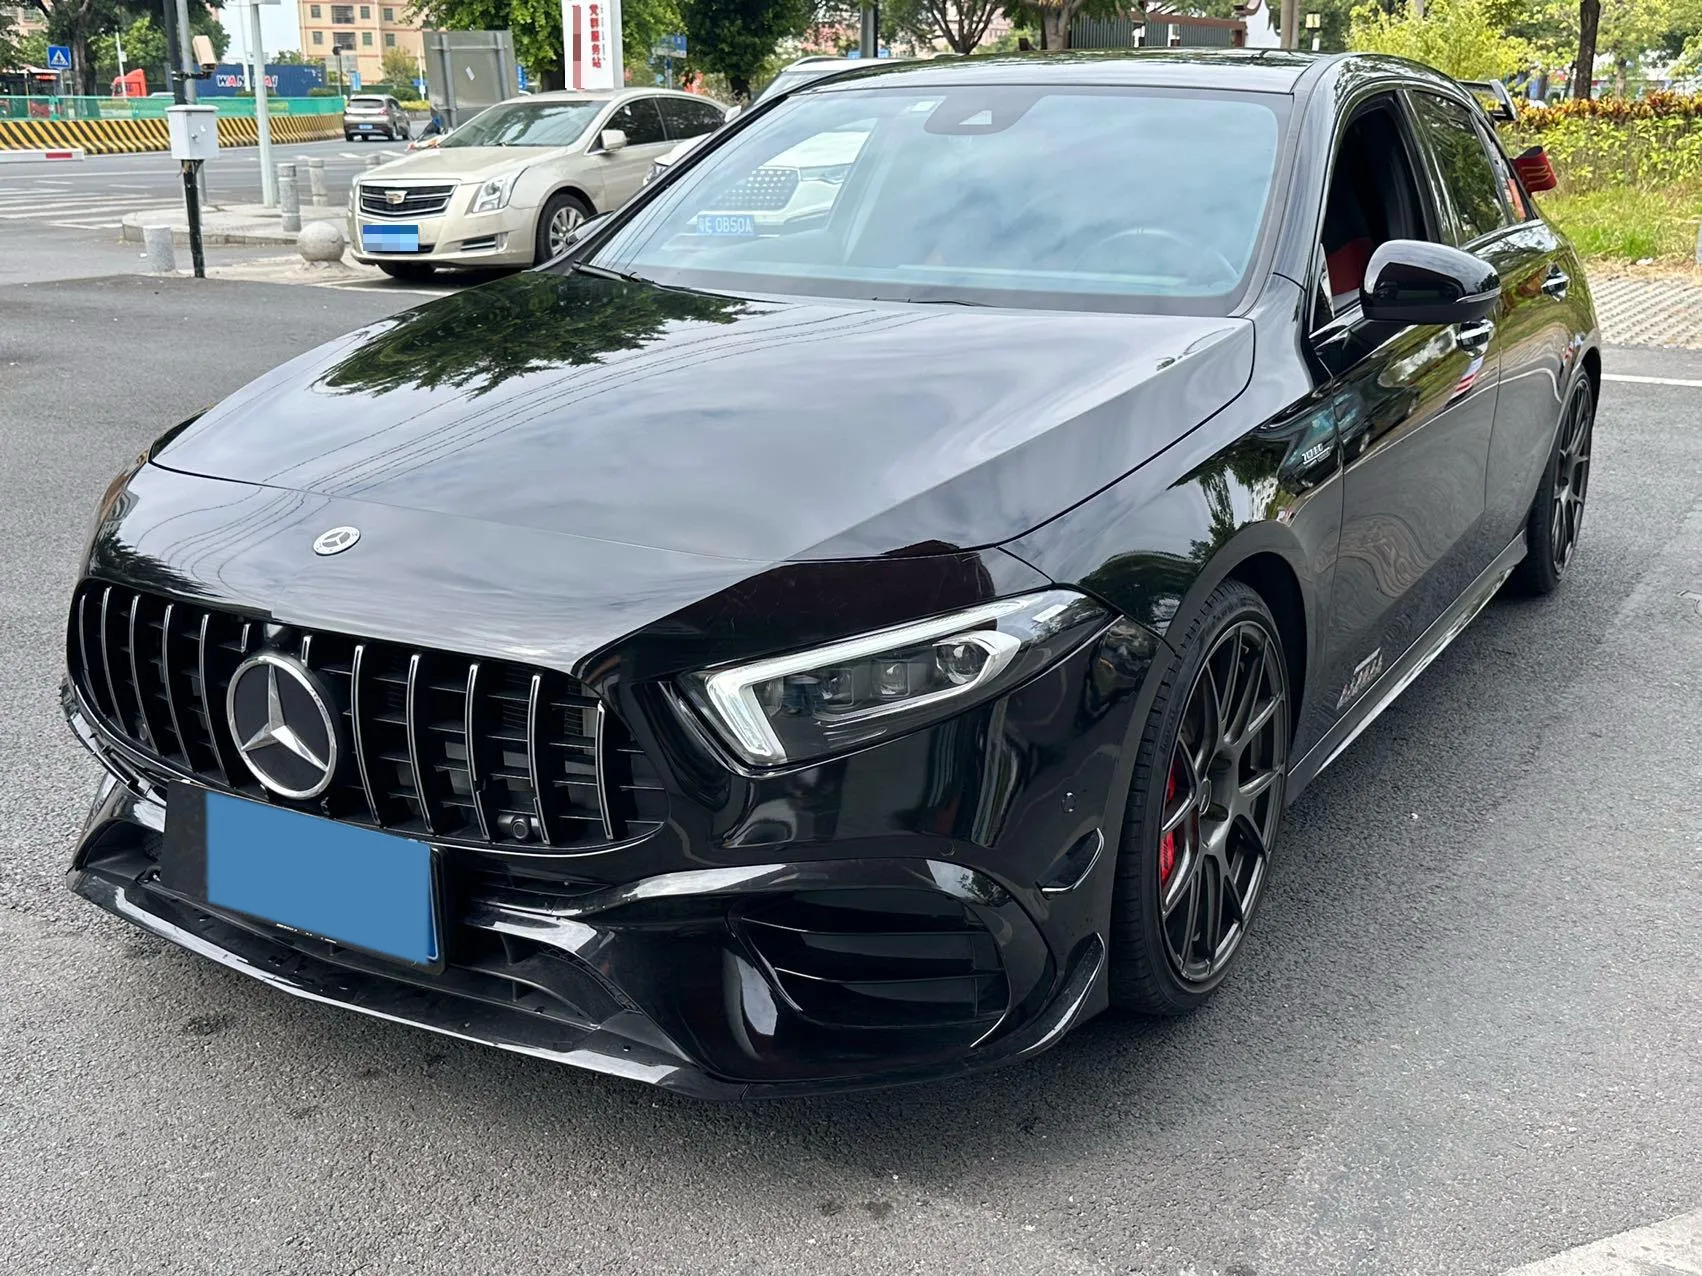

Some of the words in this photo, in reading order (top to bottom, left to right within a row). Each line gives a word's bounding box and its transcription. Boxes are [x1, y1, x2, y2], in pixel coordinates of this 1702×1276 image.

[589, 4, 601, 68] 党群服务站
